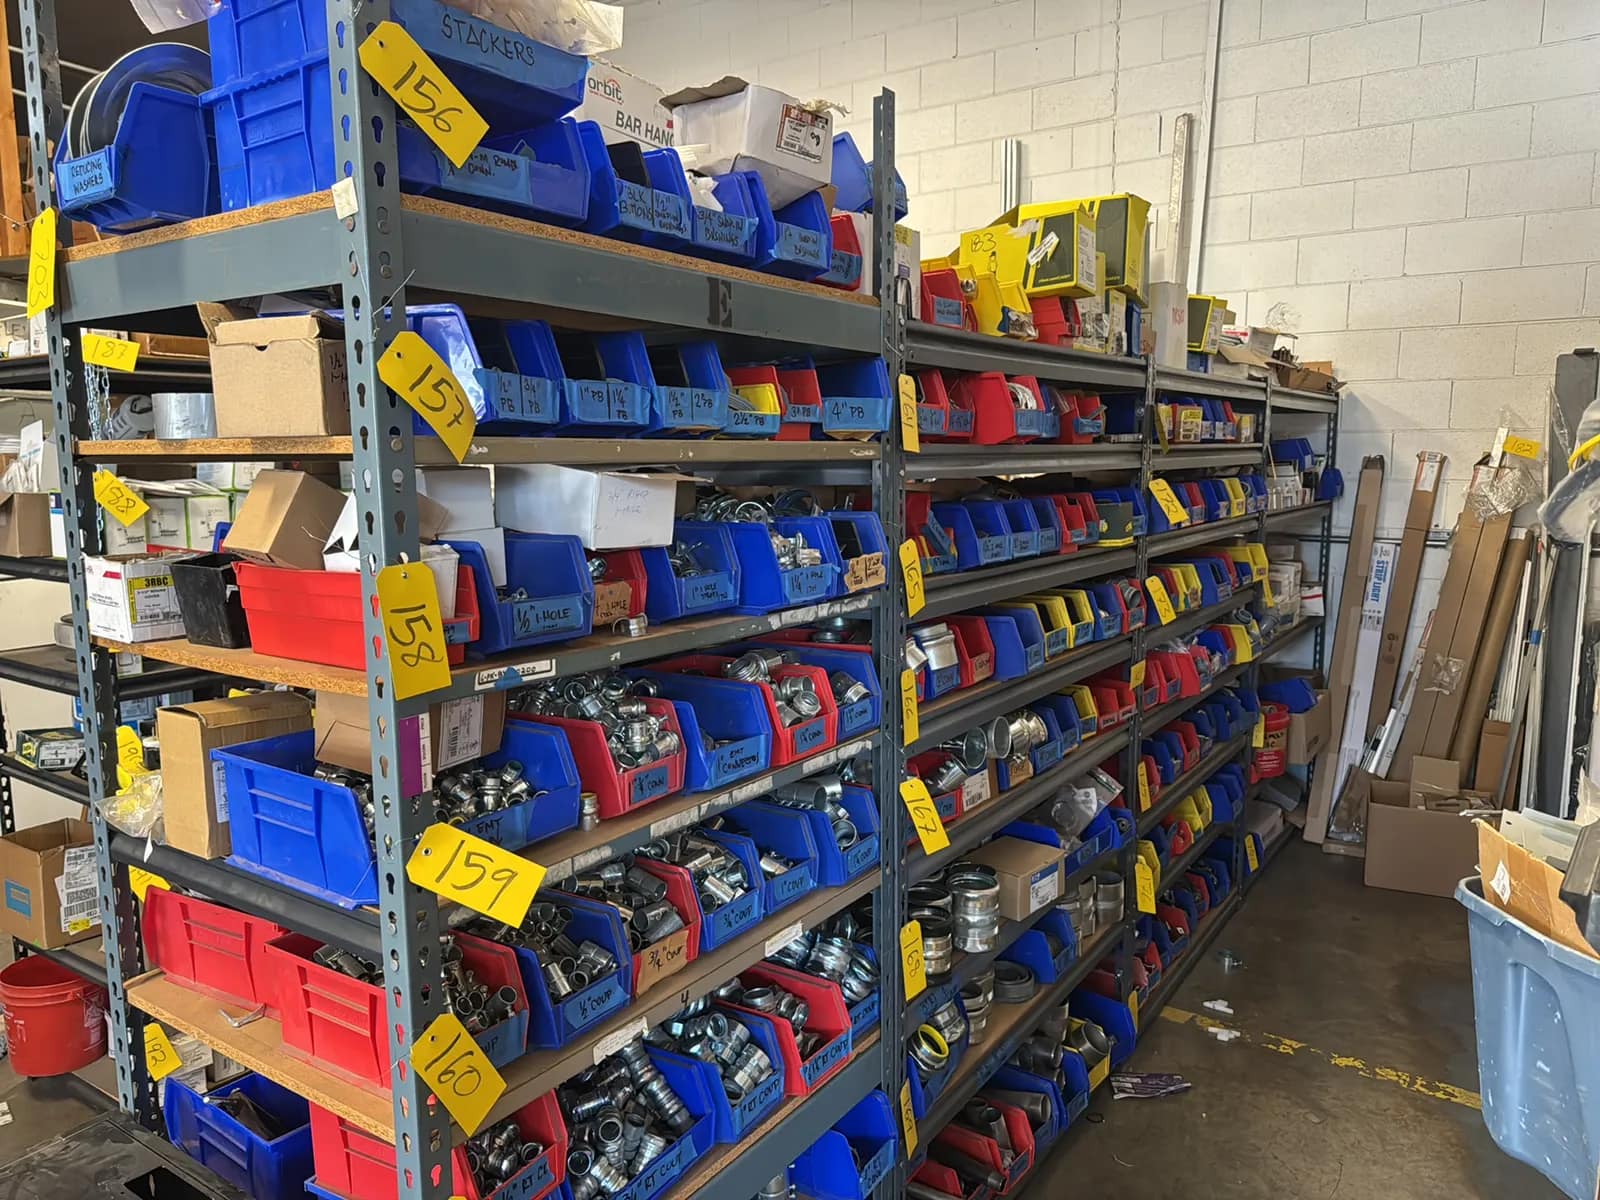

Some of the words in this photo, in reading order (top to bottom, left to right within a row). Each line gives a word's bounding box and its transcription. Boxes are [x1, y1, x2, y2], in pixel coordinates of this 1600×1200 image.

[441, 13, 535, 66] STACKERS
[393, 60, 464, 133] 156
[588, 77, 622, 101] orbit
[616, 110, 642, 135] BAR
[408, 364, 465, 428] 157
[850, 406, 865, 420] PB
[905, 559, 921, 600] 165
[1374, 559, 1386, 582] STRIP
[1370, 581, 1383, 603] LIGHT
[390, 603, 443, 667] 158
[907, 798, 937, 836] 167
[434, 838, 519, 911] 159
[425, 1032, 482, 1097] 160
